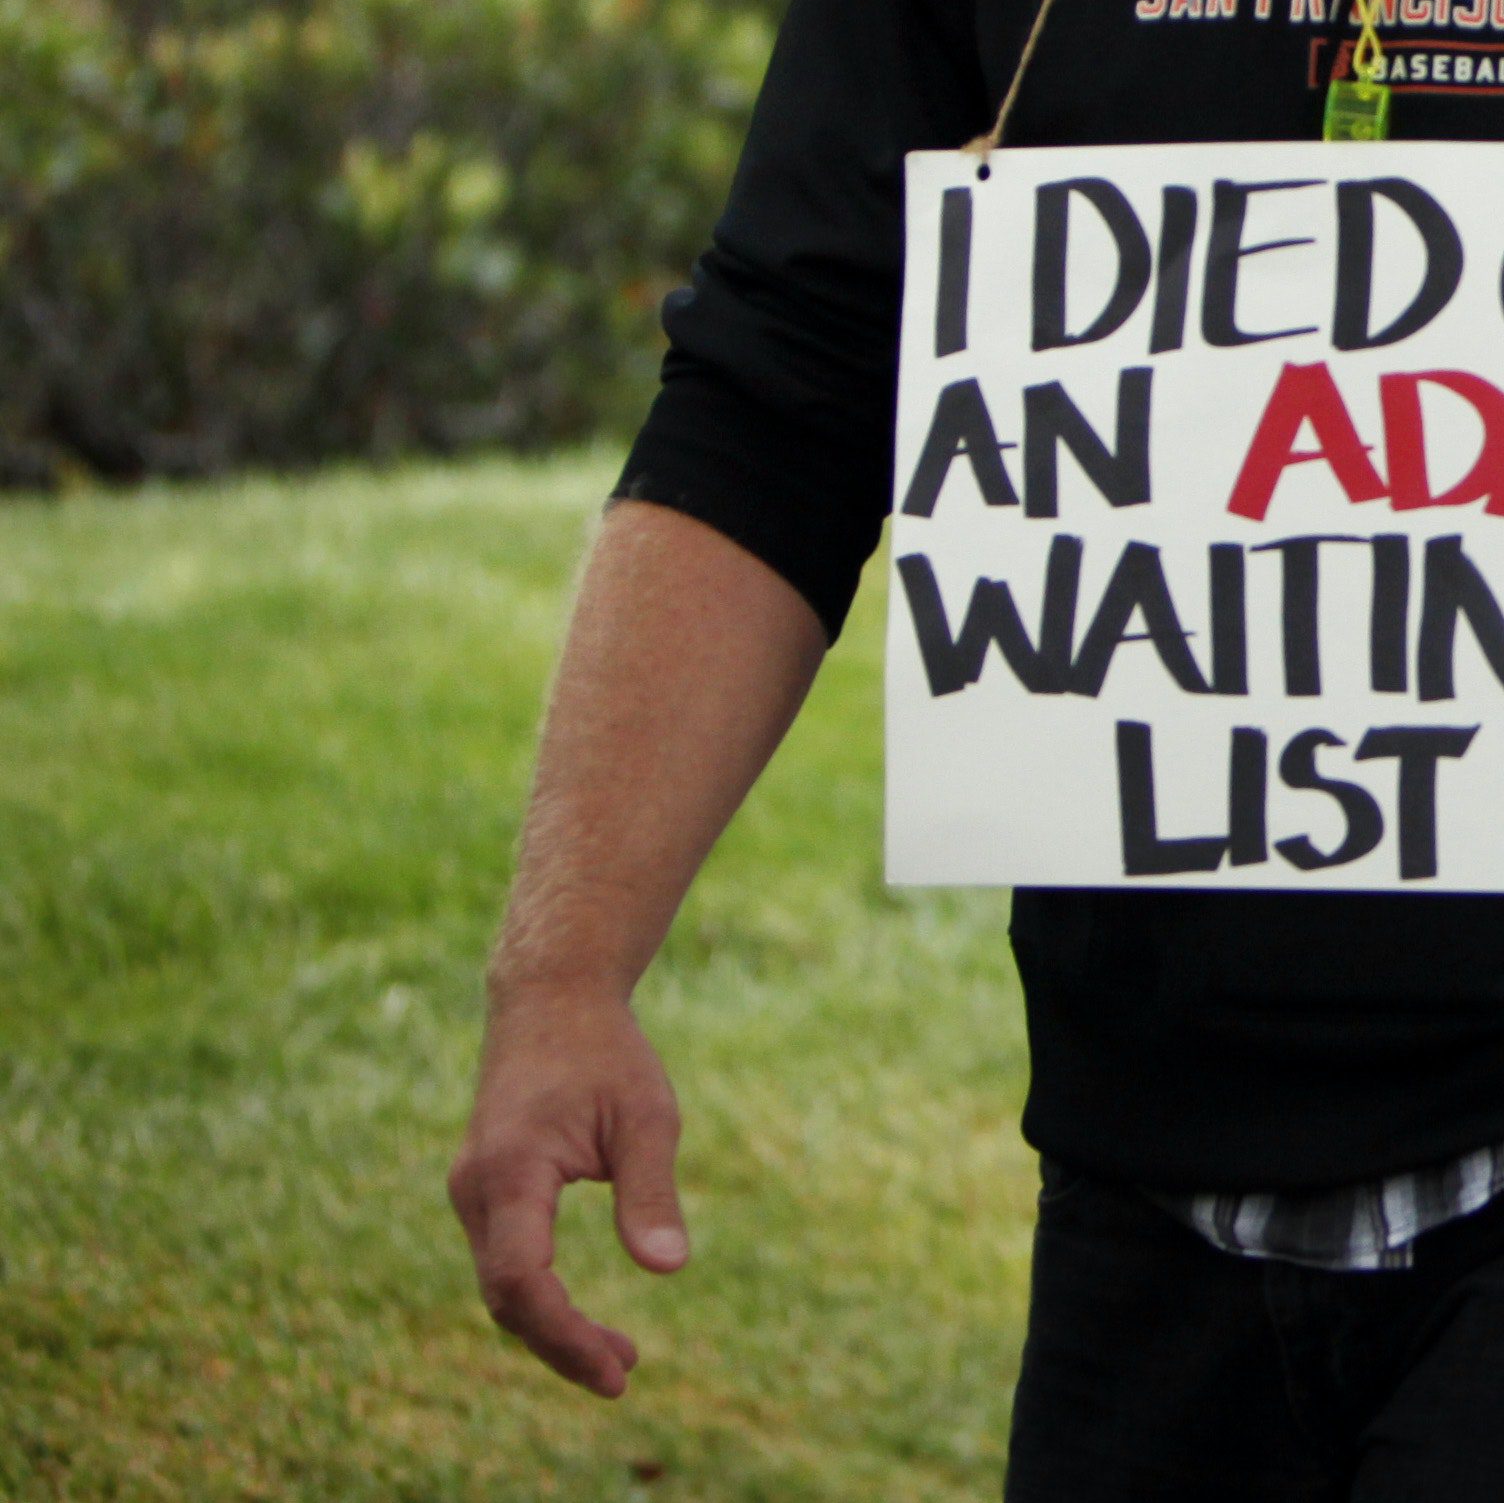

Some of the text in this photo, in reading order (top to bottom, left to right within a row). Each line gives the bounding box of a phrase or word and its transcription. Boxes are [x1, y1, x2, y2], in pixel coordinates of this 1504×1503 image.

[935, 185, 973, 358] I
[1031, 176, 1465, 354] DIED
[901, 366, 1154, 519] AN
[1115, 719, 1482, 880] LIST
